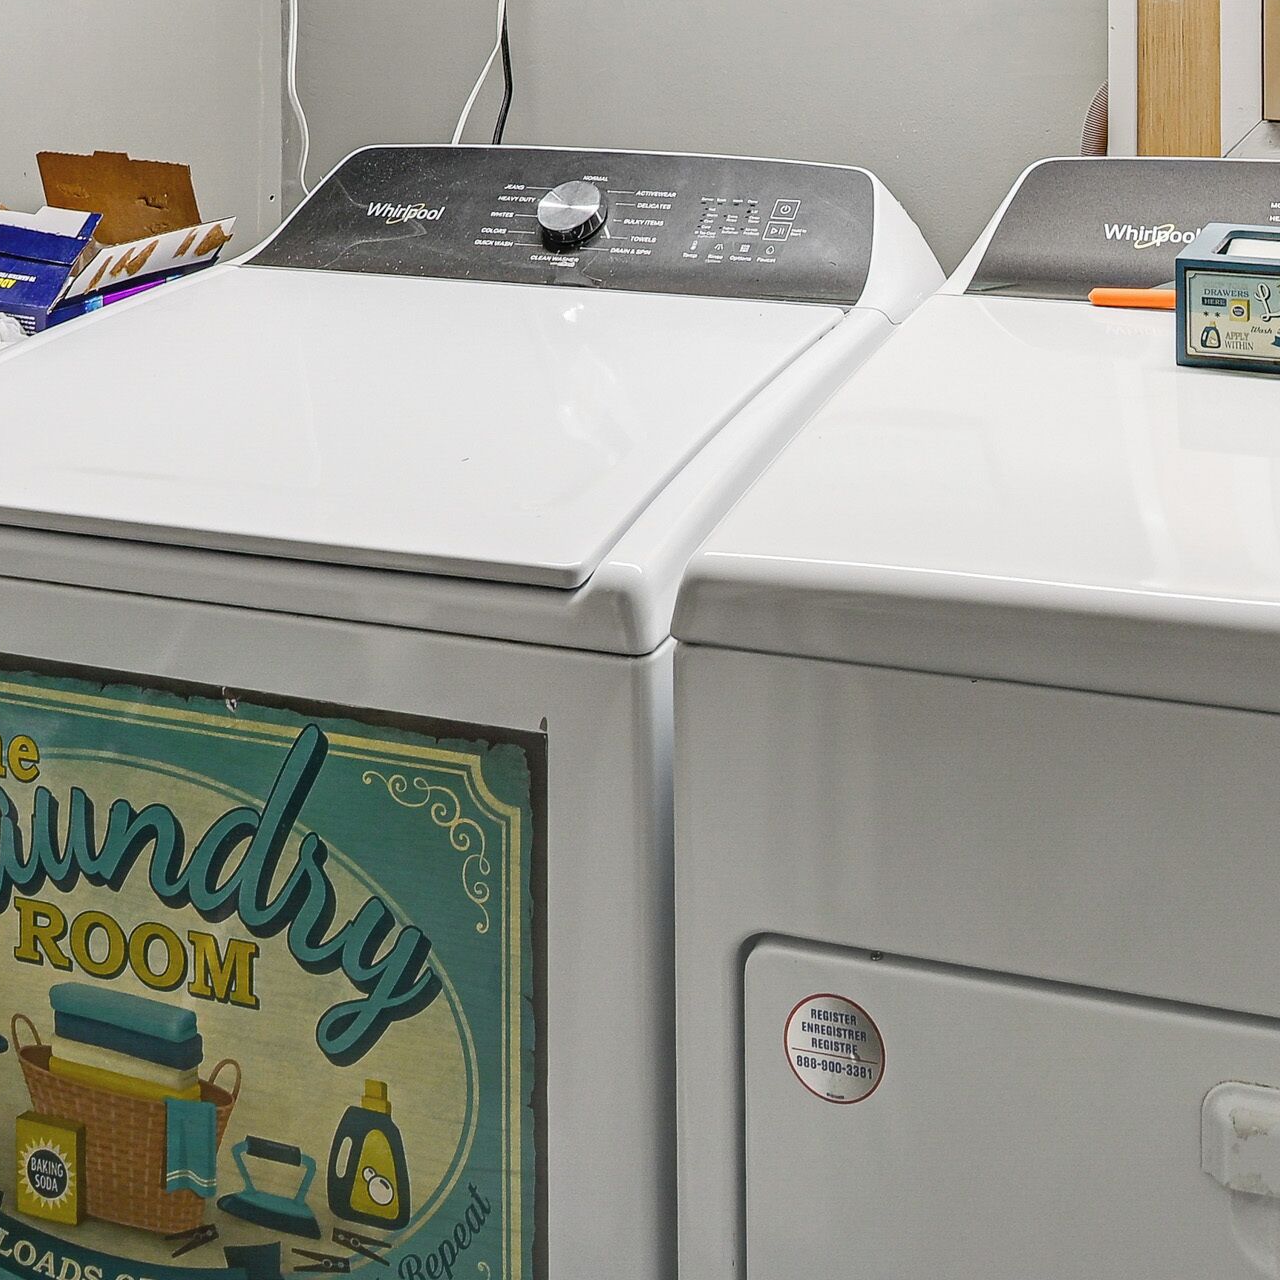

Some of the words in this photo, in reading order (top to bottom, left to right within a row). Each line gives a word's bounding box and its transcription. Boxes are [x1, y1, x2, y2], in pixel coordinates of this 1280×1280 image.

[582, 175, 609, 183] NORMAL
[504, 183, 526, 191] JEANS
[497, 195, 519, 203] HEAVY
[635, 190, 677, 198] ACTIVEWEAR
[636, 202, 671, 210] DELICATES
[366, 201, 446, 225] Whirlpool
[623, 218, 643, 226] BULKY
[643, 219, 664, 227] ITEMS
[481, 227, 507, 235] COLORS
[474, 239, 494, 247] QUICK
[530, 254, 551, 262] CLEAN
[551, 255, 579, 264] WASHER
[1203, 288, 1250, 298] DRAWERS
[1203, 298, 1226, 306] HERE
[1250, 325, 1273, 335] Wash
[1225, 331, 1250, 341] APPLY
[1224, 340, 1255, 352] WITHIN
[13, 895, 260, 1010] ROOM
[810, 1008, 857, 1027] REGISTER
[801, 1021, 867, 1043] ENREGISTRER
[811, 1037, 858, 1056] REGISTRE
[796, 1055, 873, 1080] 888-900-3381
[31, 1157, 64, 1178] BAKING
[34, 1174, 59, 1193] SODA
